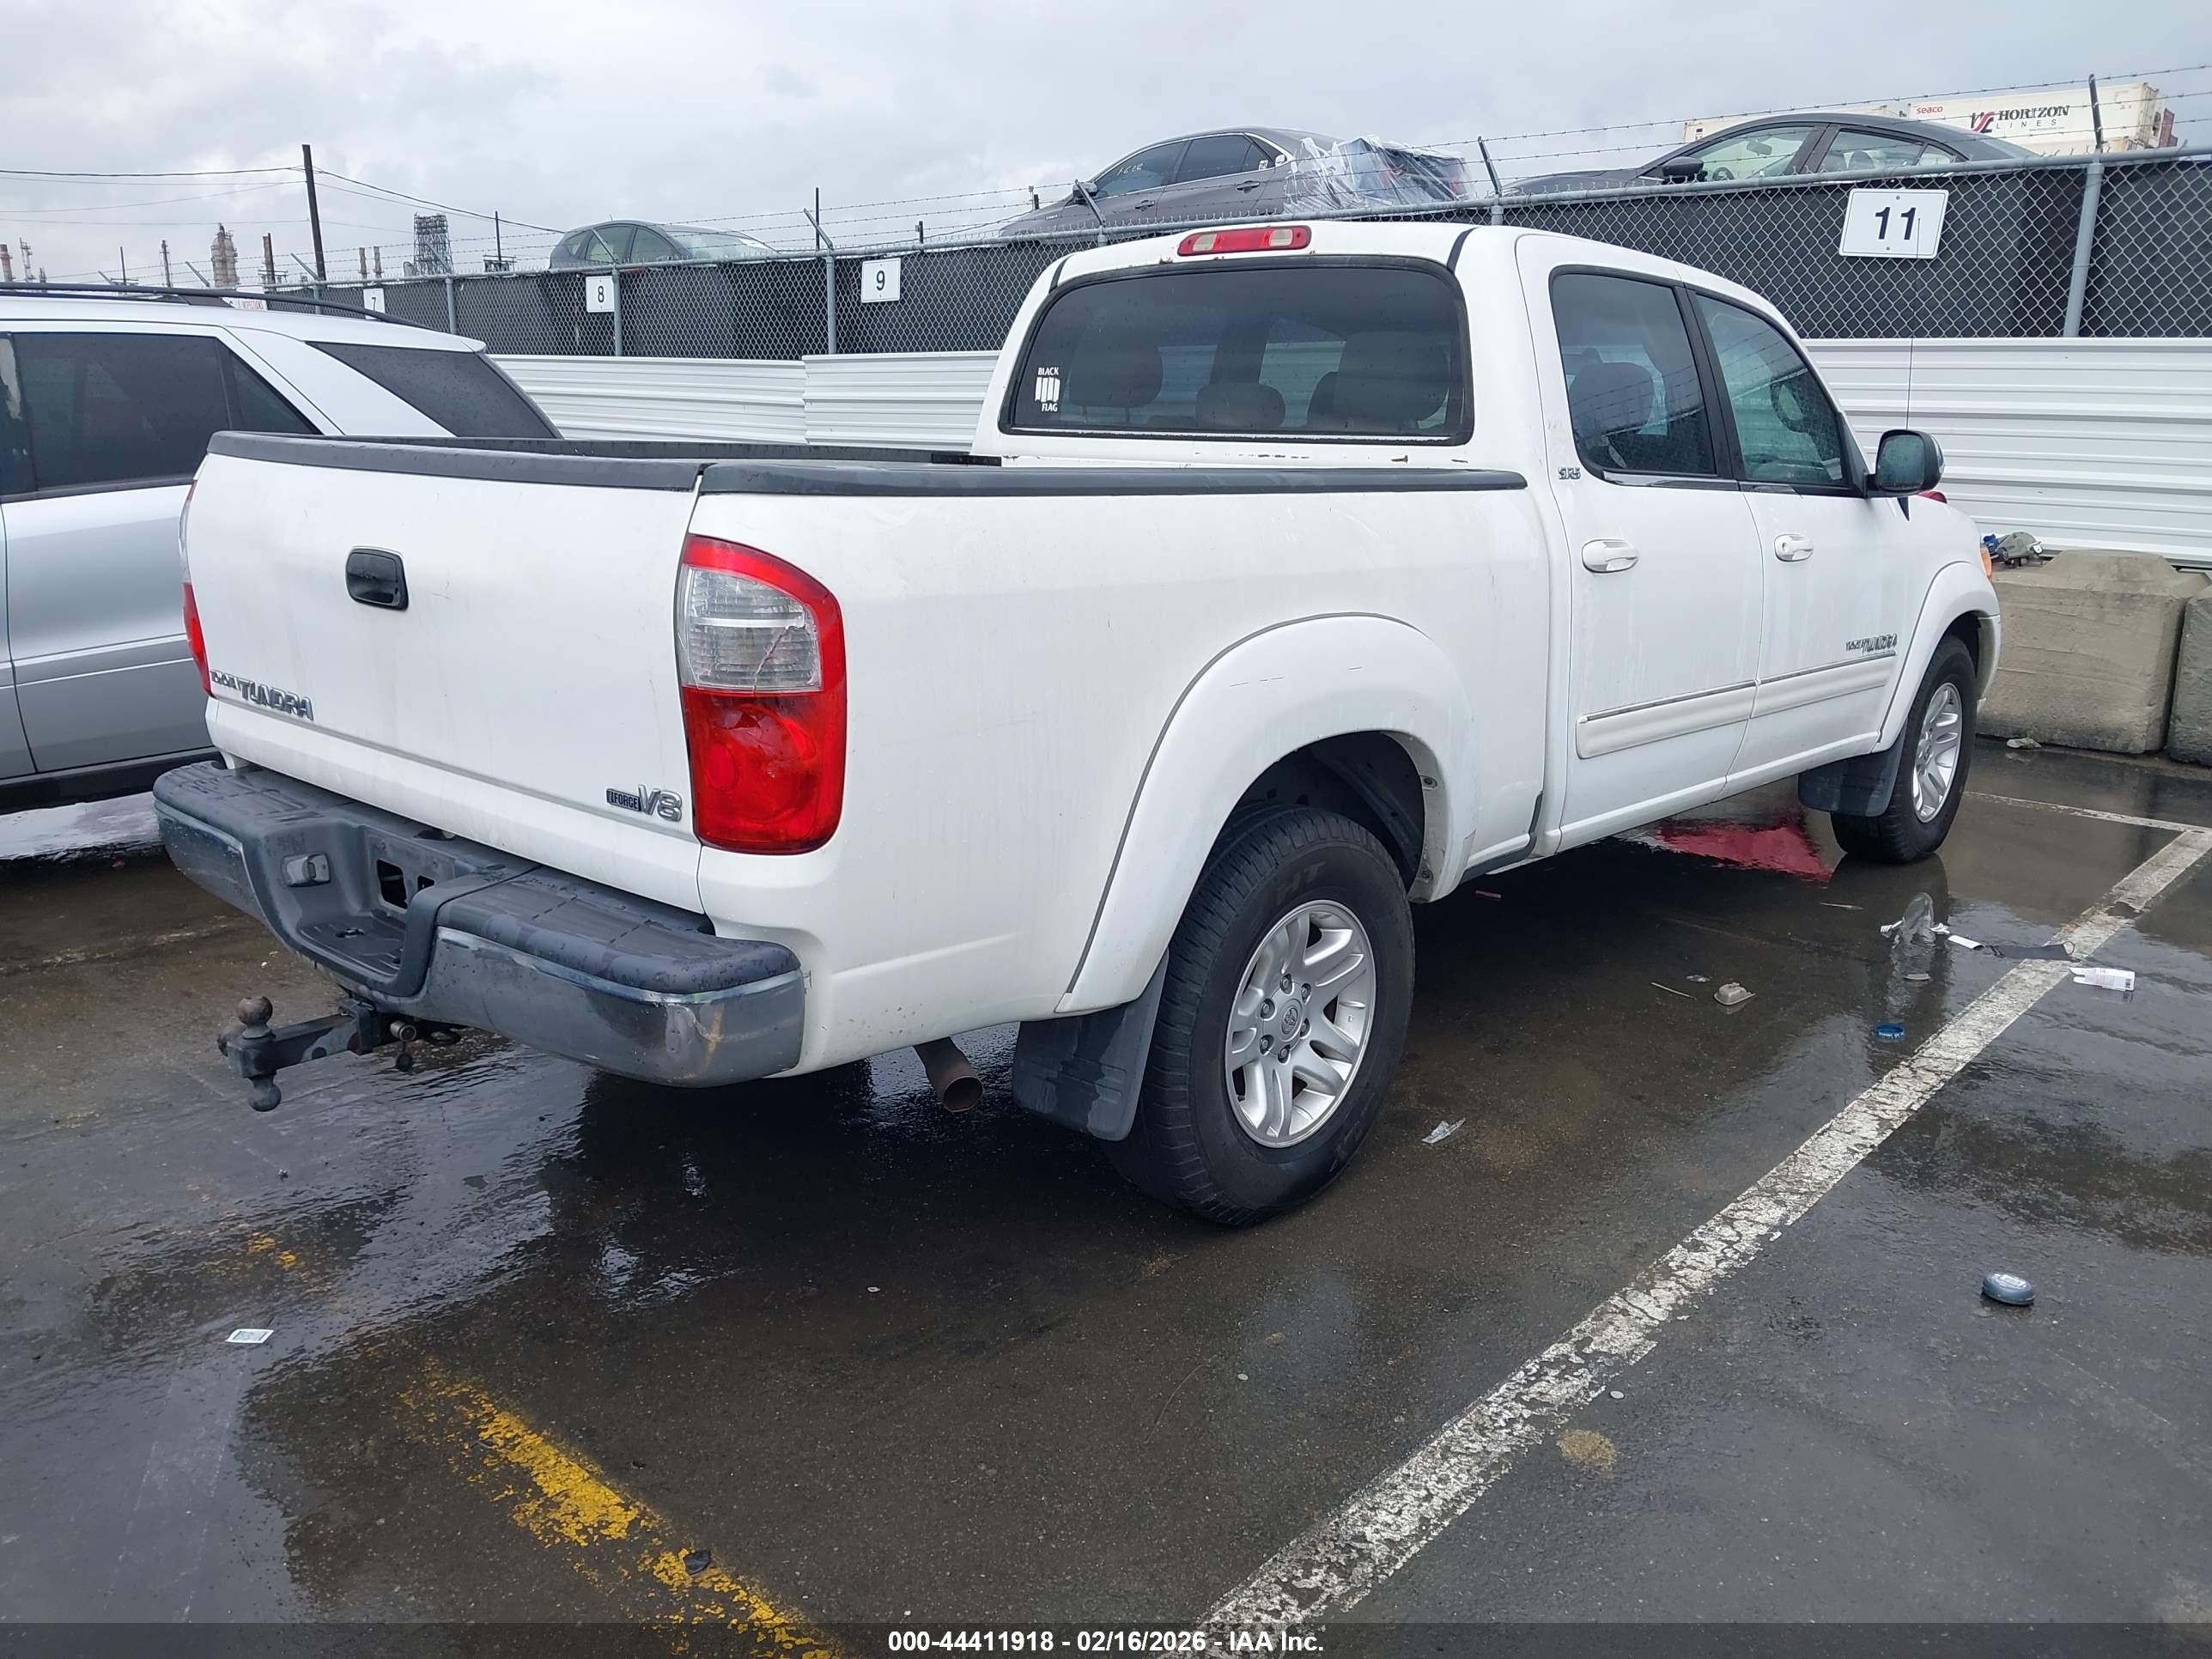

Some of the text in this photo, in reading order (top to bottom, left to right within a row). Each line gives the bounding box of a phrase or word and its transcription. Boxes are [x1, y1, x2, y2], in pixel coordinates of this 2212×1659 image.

[1916, 105, 1943, 114] seaco
[1998, 105, 2070, 121] HORIZON
[1996, 118, 2057, 130] LINES
[1875, 206, 1917, 240] 11
[876, 270, 885, 291] 9
[597, 285, 605, 303] 8
[371, 296, 377, 312] 7
[1037, 367, 1060, 376] BLACK
[1041, 403, 1058, 412] FLAG
[239, 677, 314, 721] TUNDRA
[638, 784, 683, 822] V8
